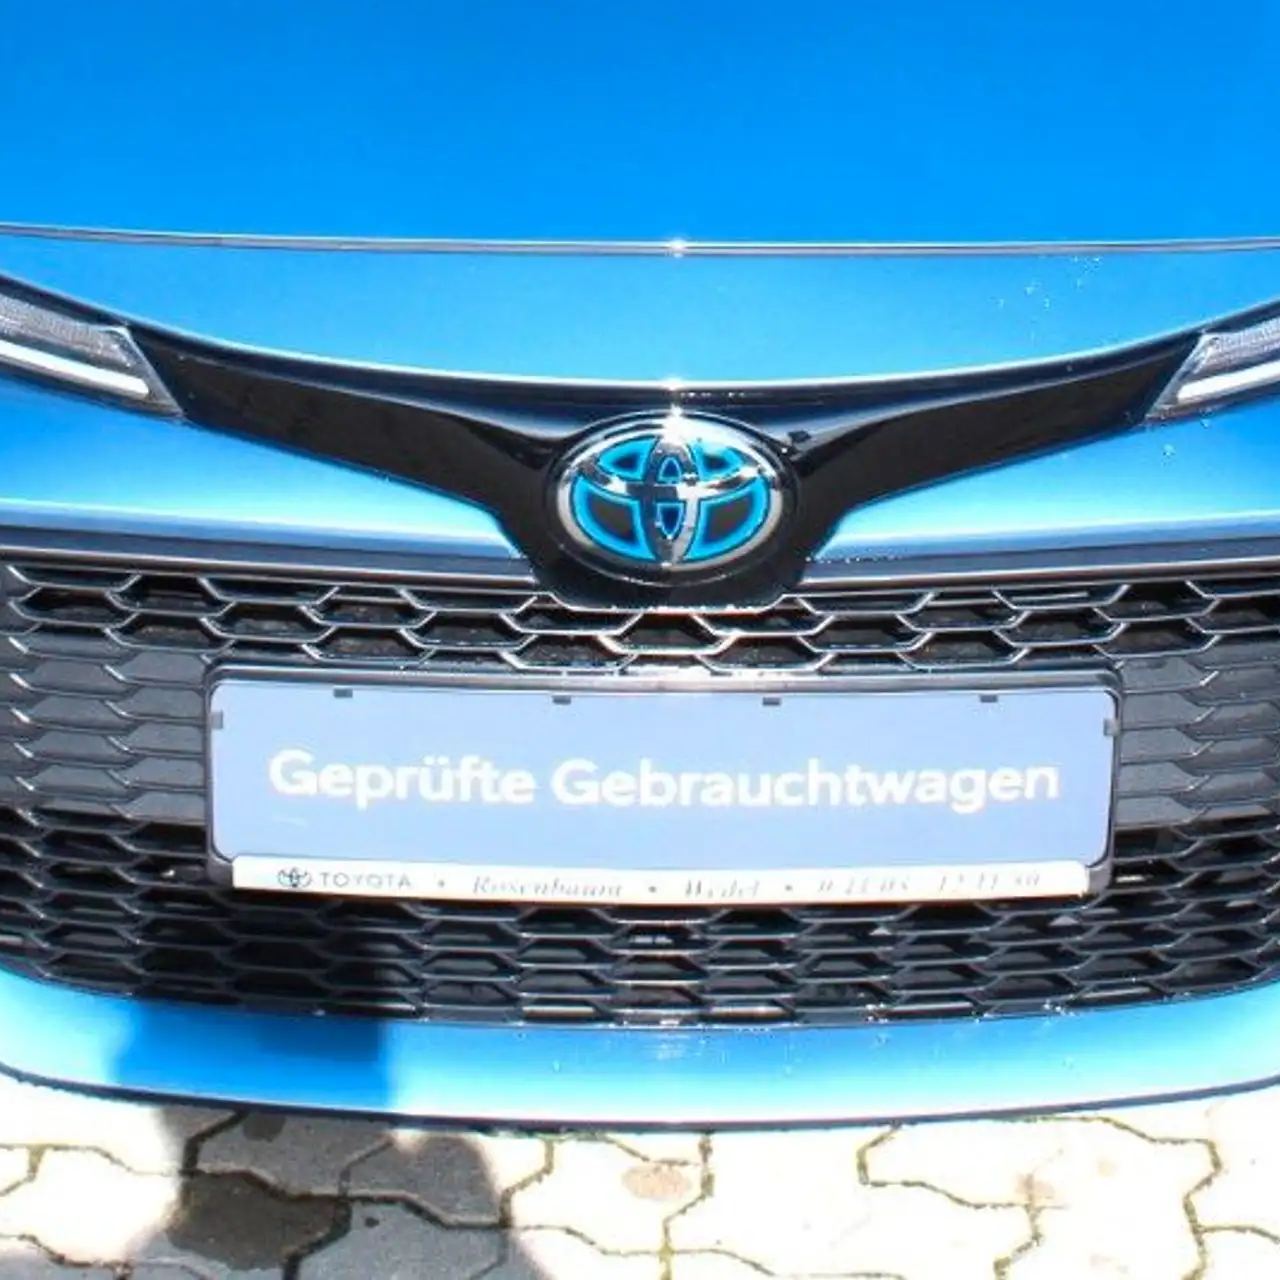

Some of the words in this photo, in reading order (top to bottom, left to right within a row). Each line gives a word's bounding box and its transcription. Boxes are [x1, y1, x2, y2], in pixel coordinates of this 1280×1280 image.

[268, 747, 536, 810] Geprüfte
[550, 756, 1061, 813] Gebrauchtwagen
[319, 871, 413, 889] TOYOTA
